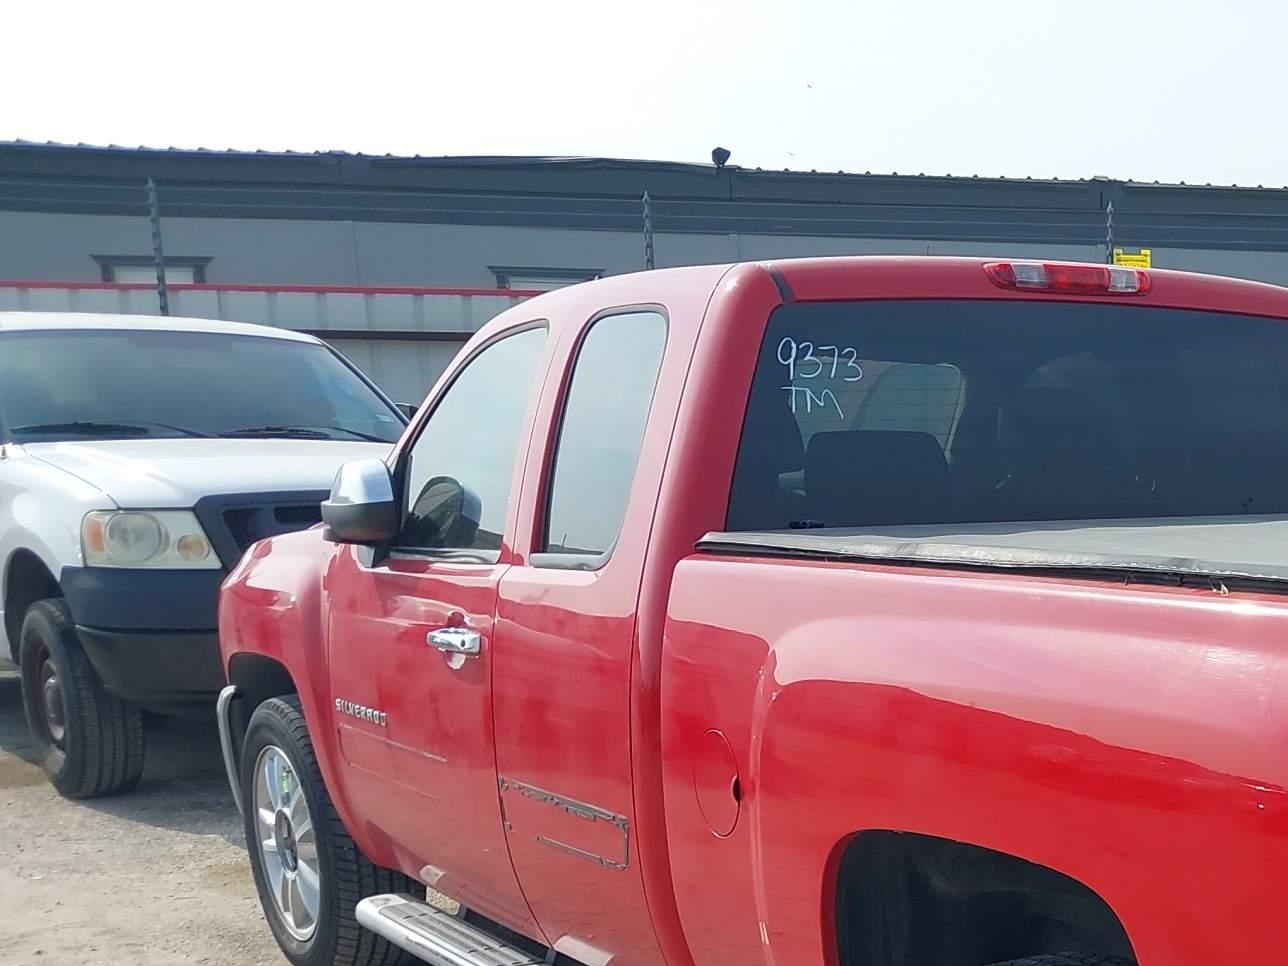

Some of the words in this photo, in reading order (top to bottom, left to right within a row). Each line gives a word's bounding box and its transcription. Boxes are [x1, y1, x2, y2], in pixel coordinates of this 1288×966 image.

[777, 337, 863, 381] 9373
[778, 385, 844, 420] TM
[335, 698, 387, 727] SILVERADO
